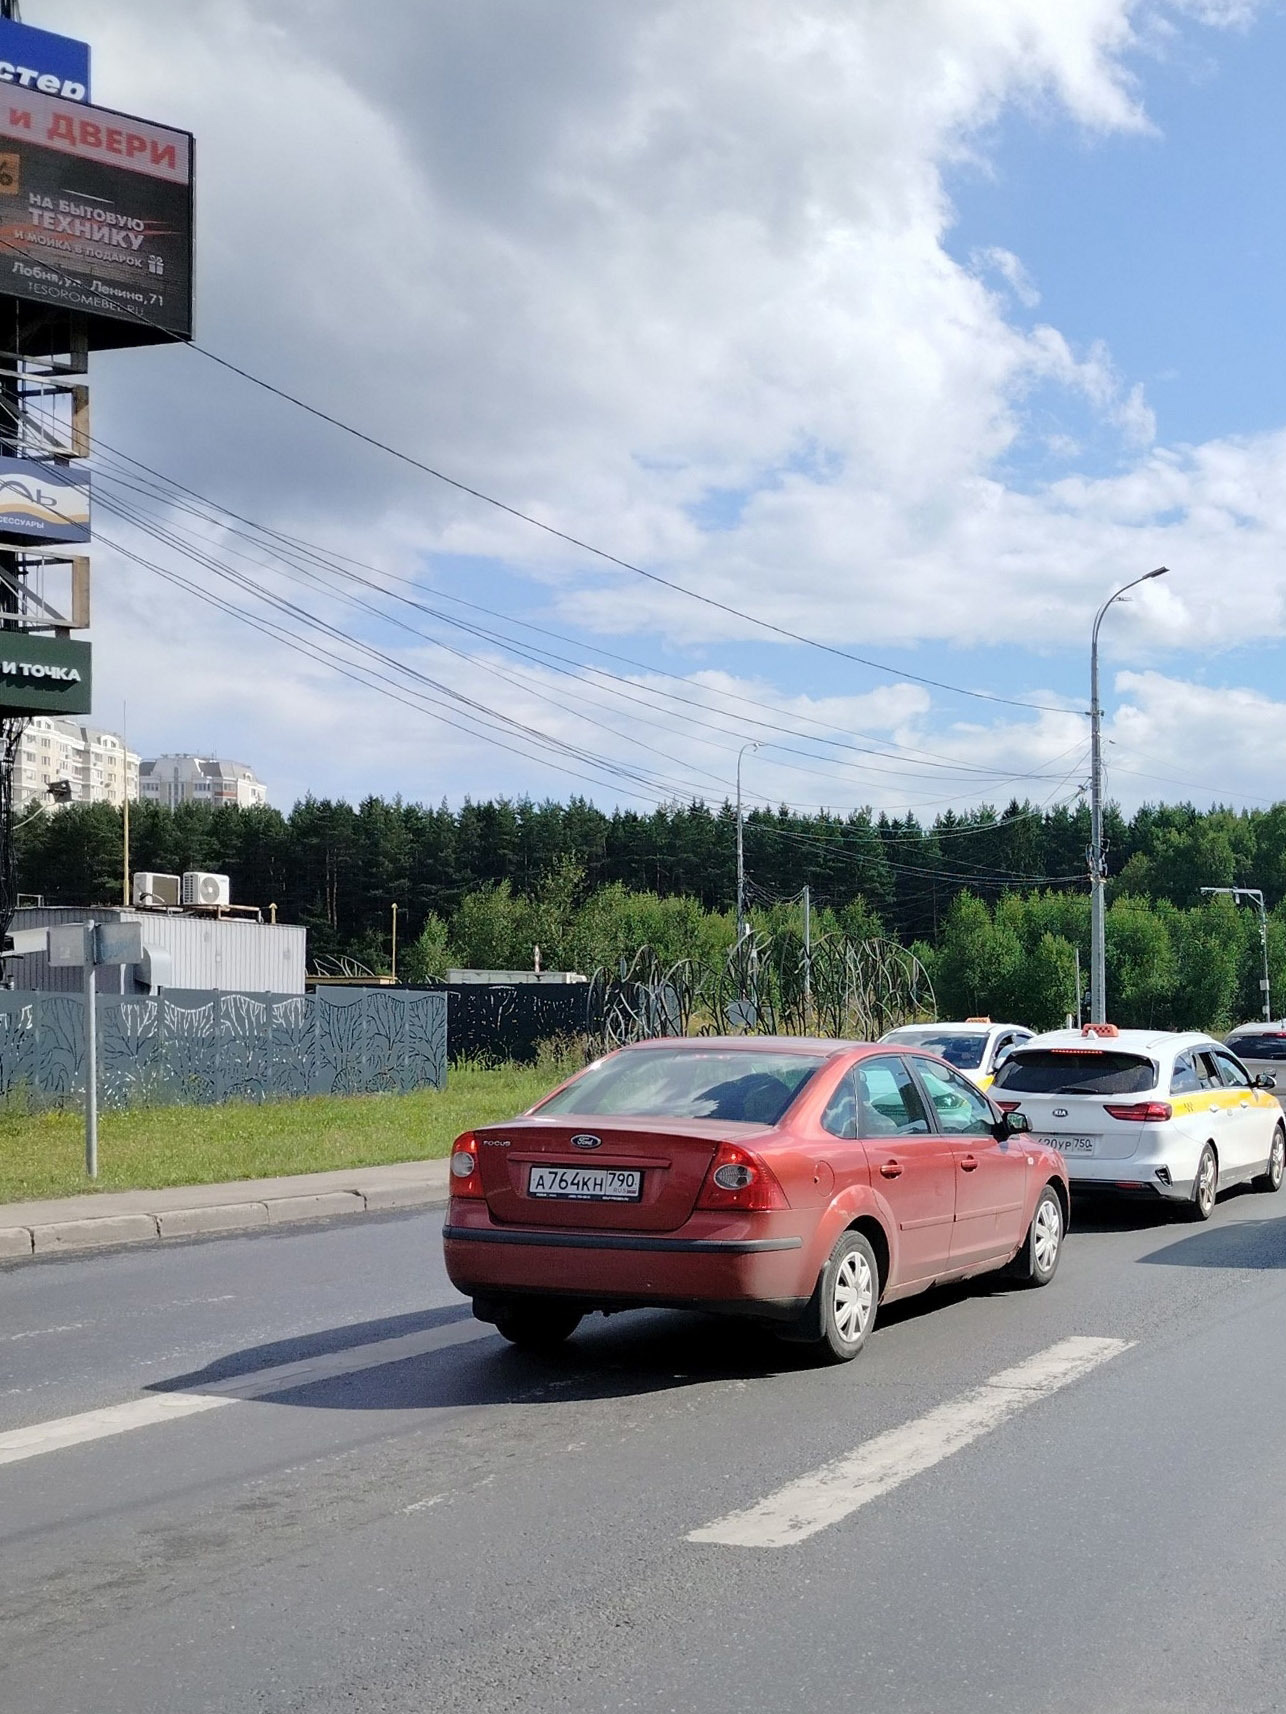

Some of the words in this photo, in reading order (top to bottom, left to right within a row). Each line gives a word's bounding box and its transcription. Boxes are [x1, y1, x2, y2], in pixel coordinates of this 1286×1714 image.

[47, 112, 176, 170] ДВЕРИ
[28, 207, 144, 251] ТЕХНИКУ
[29, 192, 53, 209] НА
[59, 200, 145, 232] БЫТОВУЮ
[27, 231, 71, 251] МОЙКА
[86, 247, 143, 268] ПОДАРОК
[2, 661, 17, 675] И
[19, 663, 81, 681] ТОЧКА
[608, 1172, 635, 1188] 790
